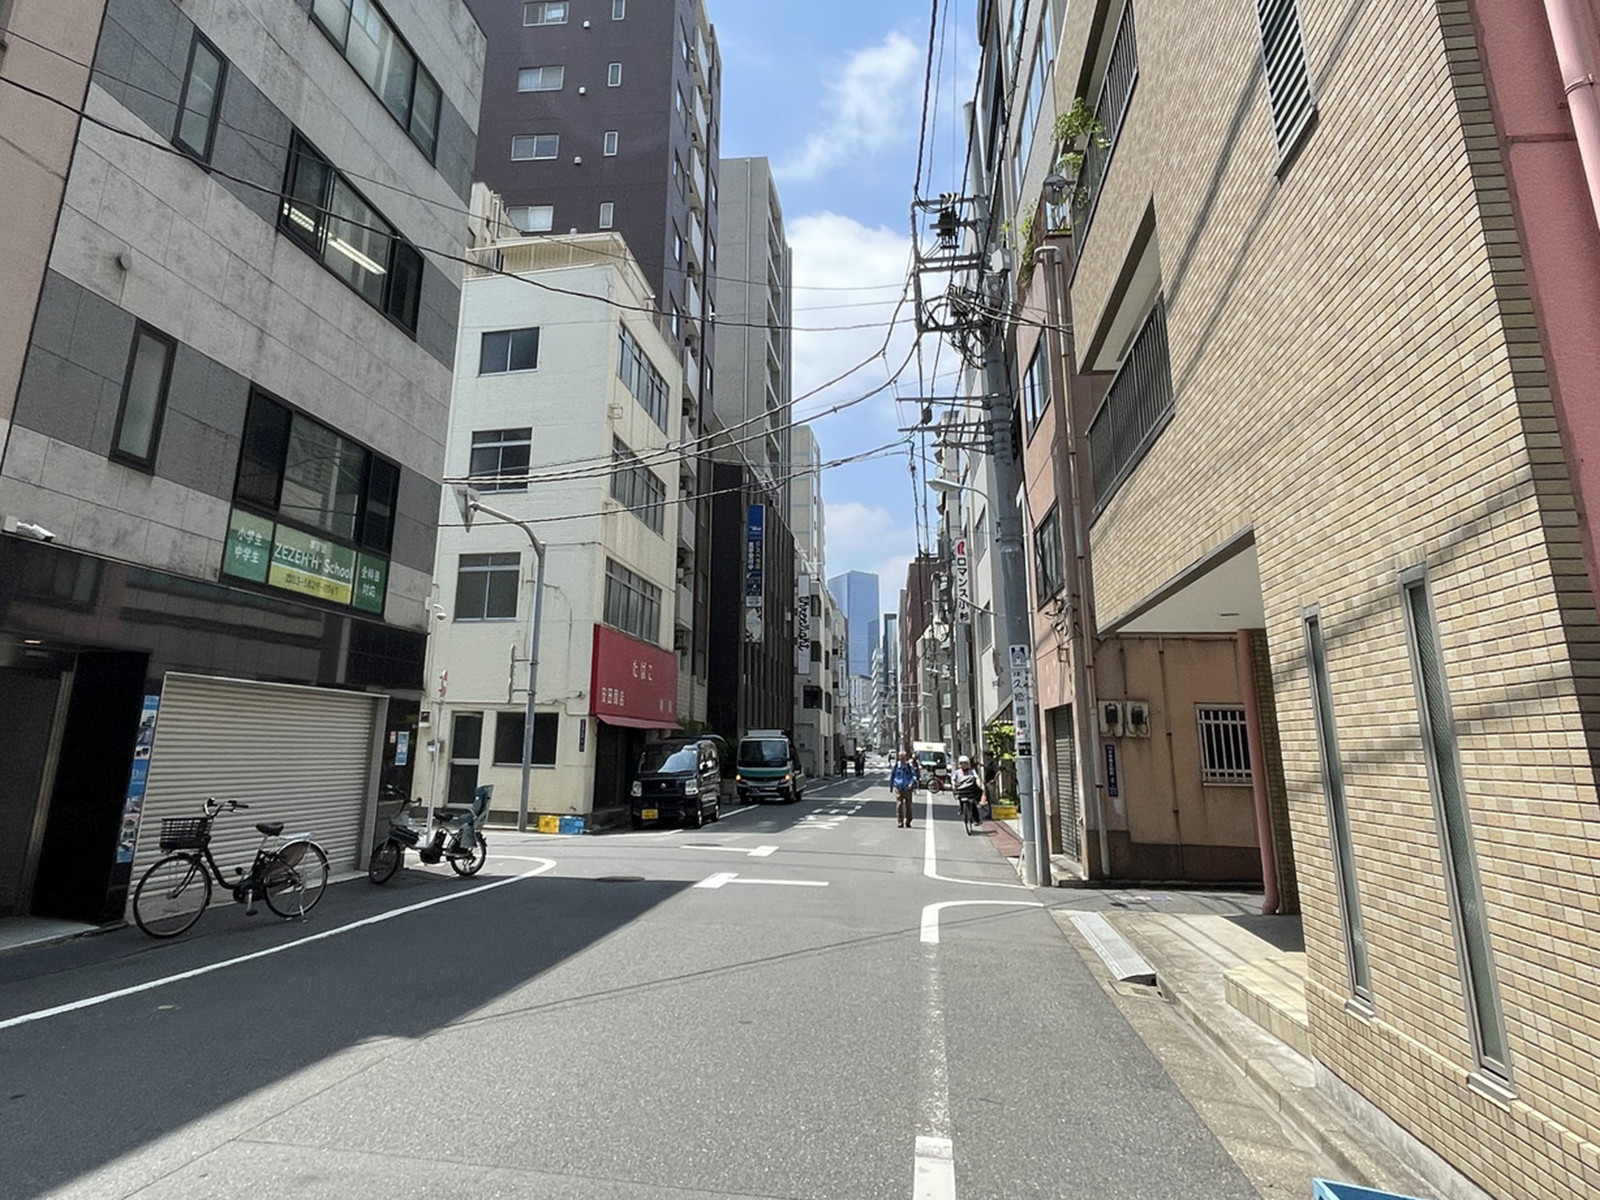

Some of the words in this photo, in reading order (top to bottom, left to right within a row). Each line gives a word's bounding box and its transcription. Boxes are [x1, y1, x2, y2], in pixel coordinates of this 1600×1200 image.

[237, 526, 263, 547] 小学生
[234, 545, 260, 564] 中学生
[323, 558, 354, 580] School
[362, 582, 377, 598] 対応
[957, 557, 970, 621] ロマンス小杉
[632, 659, 654, 681] たばこ
